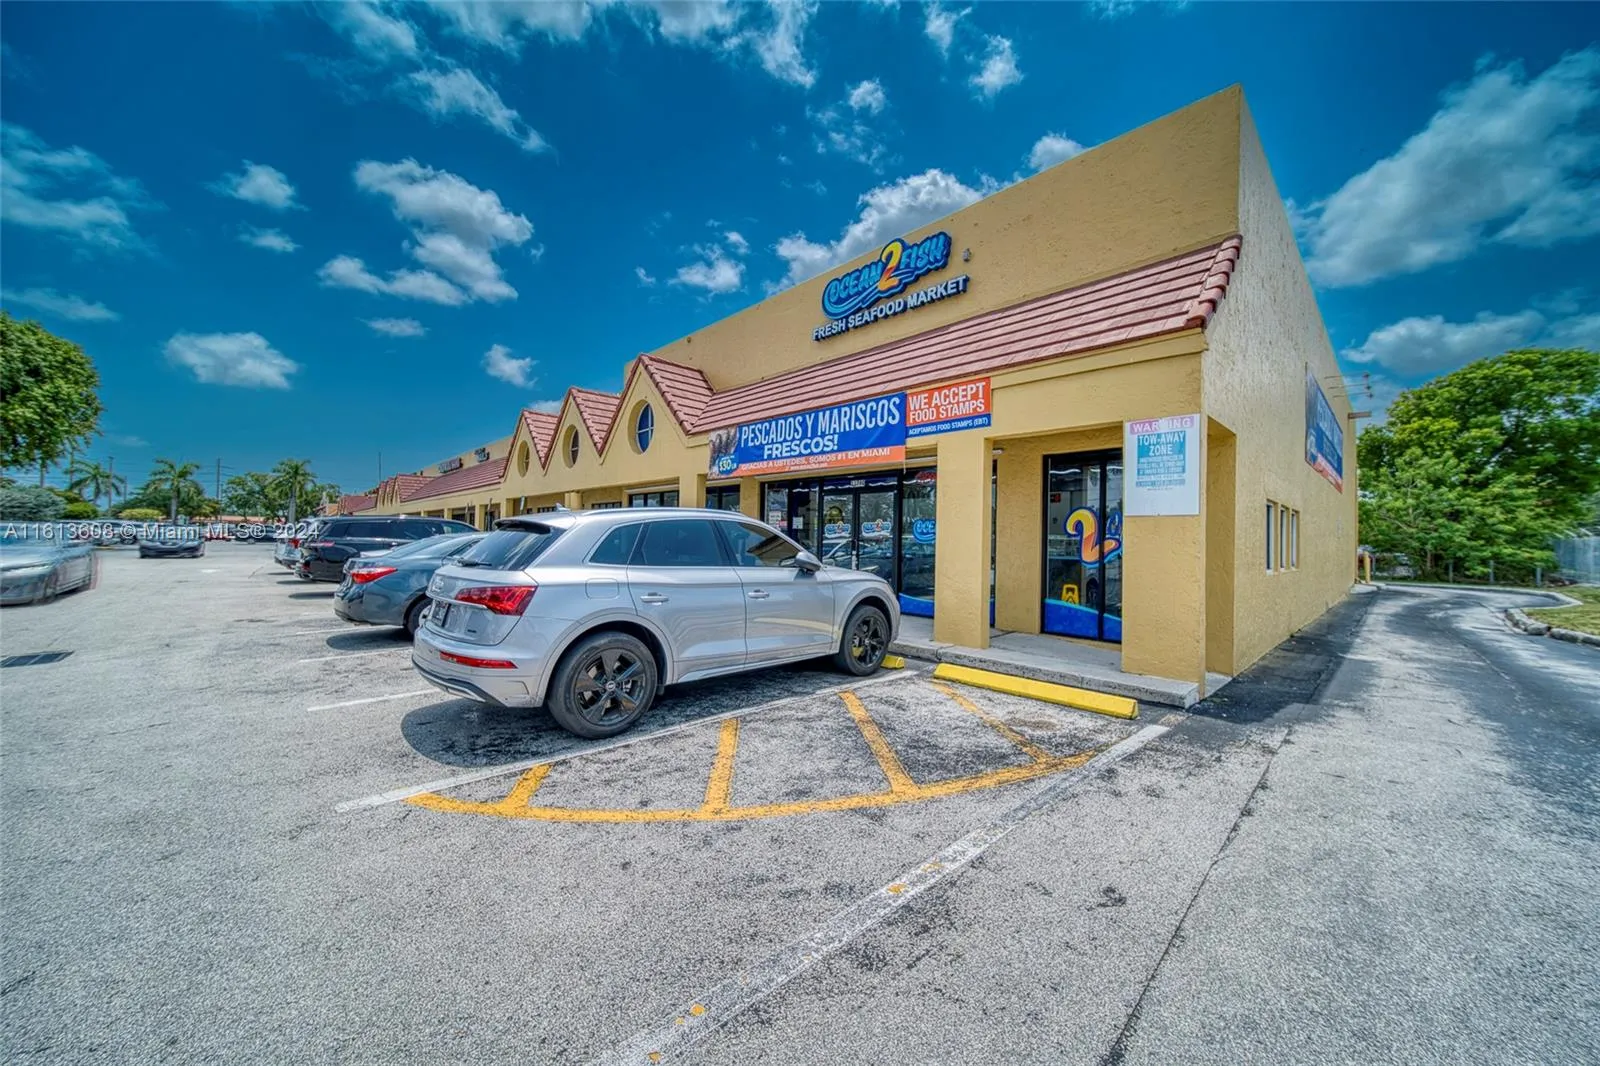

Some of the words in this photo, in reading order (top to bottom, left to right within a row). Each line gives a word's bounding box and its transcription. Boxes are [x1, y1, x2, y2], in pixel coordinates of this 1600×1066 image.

[812, 318, 847, 340] FRESH
[847, 298, 904, 329] SEAFOOD
[906, 276, 967, 308] MARKET
[909, 393, 929, 411] WE
[931, 381, 986, 407] ACCEPT
[909, 407, 937, 424] FOOD
[939, 398, 985, 419] STAMPS
[740, 413, 804, 448] PESCADOS
[805, 414, 816, 436] Y
[816, 396, 901, 436] MARISCOS
[937, 422, 951, 431] FOOD
[951, 419, 973, 429] STAMPS
[1133, 417, 1191, 433] WARING
[763, 435, 839, 460] FRESCOS!
[1138, 431, 1185, 446] TOW-AWAY
[809, 453, 836, 464] SOMOS
[848, 450, 861, 459] EN
[862, 447, 890, 458] MIAMI
[1148, 444, 1173, 457] ZONE
